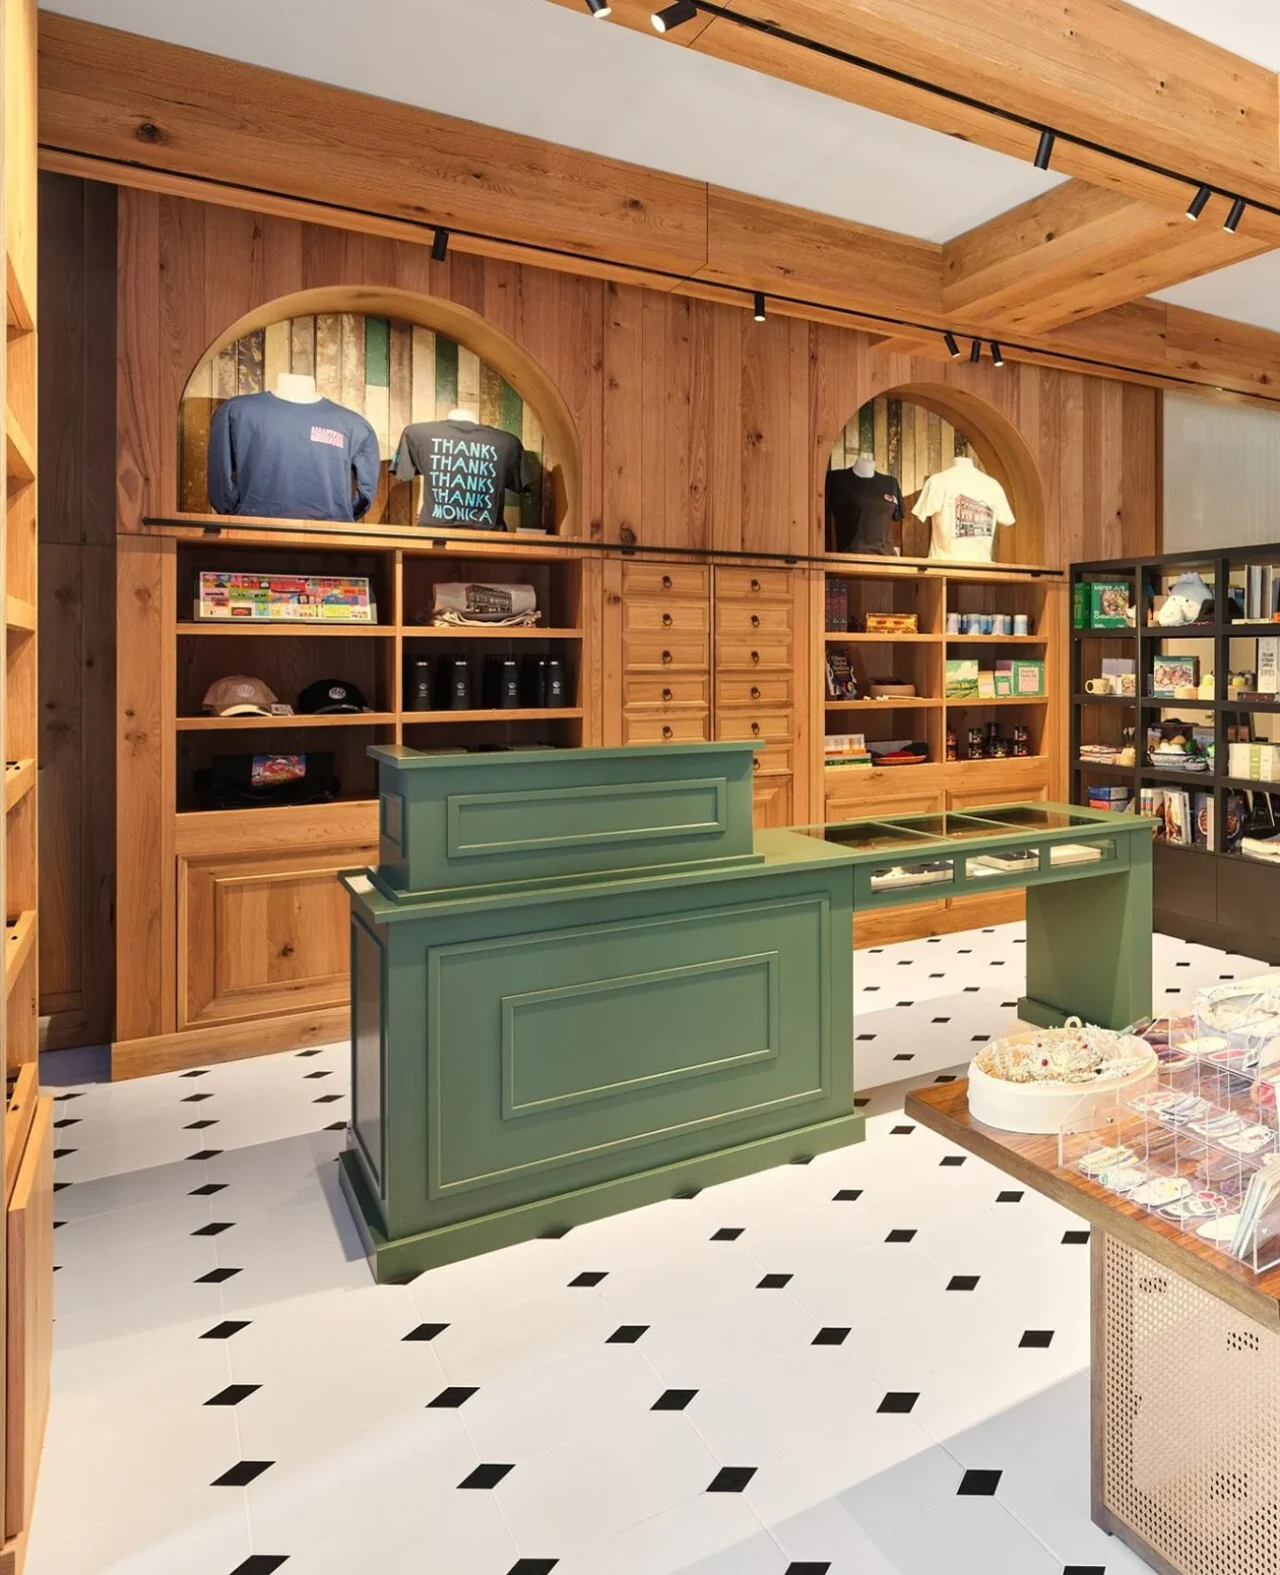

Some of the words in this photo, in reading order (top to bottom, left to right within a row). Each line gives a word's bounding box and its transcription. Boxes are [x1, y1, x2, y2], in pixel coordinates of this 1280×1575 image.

[431, 438, 498, 461] THANKS
[430, 454, 496, 478] THANKS
[429, 471, 495, 493] THANKS
[431, 488, 492, 509] THANKS
[431, 503, 493, 524] MONICA
